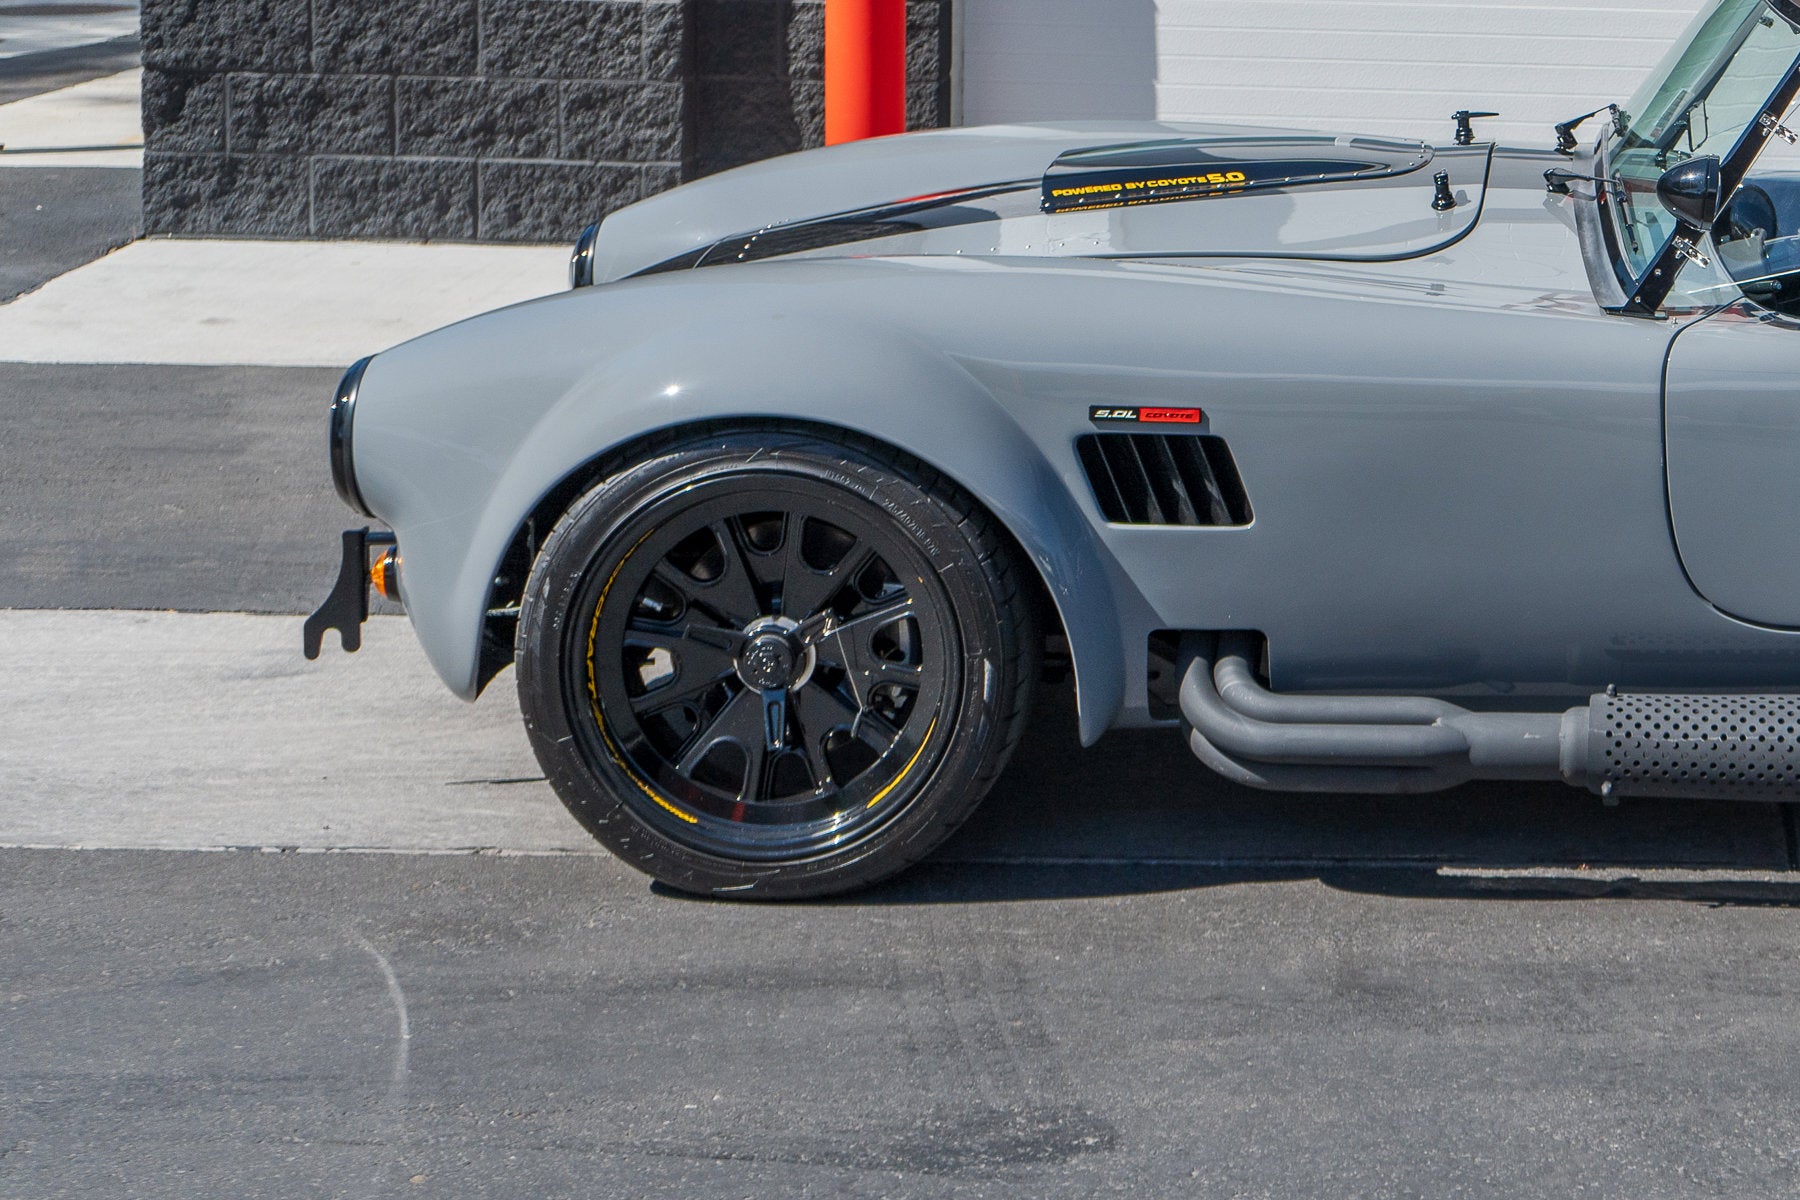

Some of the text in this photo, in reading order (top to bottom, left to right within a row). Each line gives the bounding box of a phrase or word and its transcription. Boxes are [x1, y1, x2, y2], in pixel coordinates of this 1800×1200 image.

[1051, 171, 1246, 197] POWERED BY COYOTE 5.0
[1094, 409, 1137, 419] 5.0L
